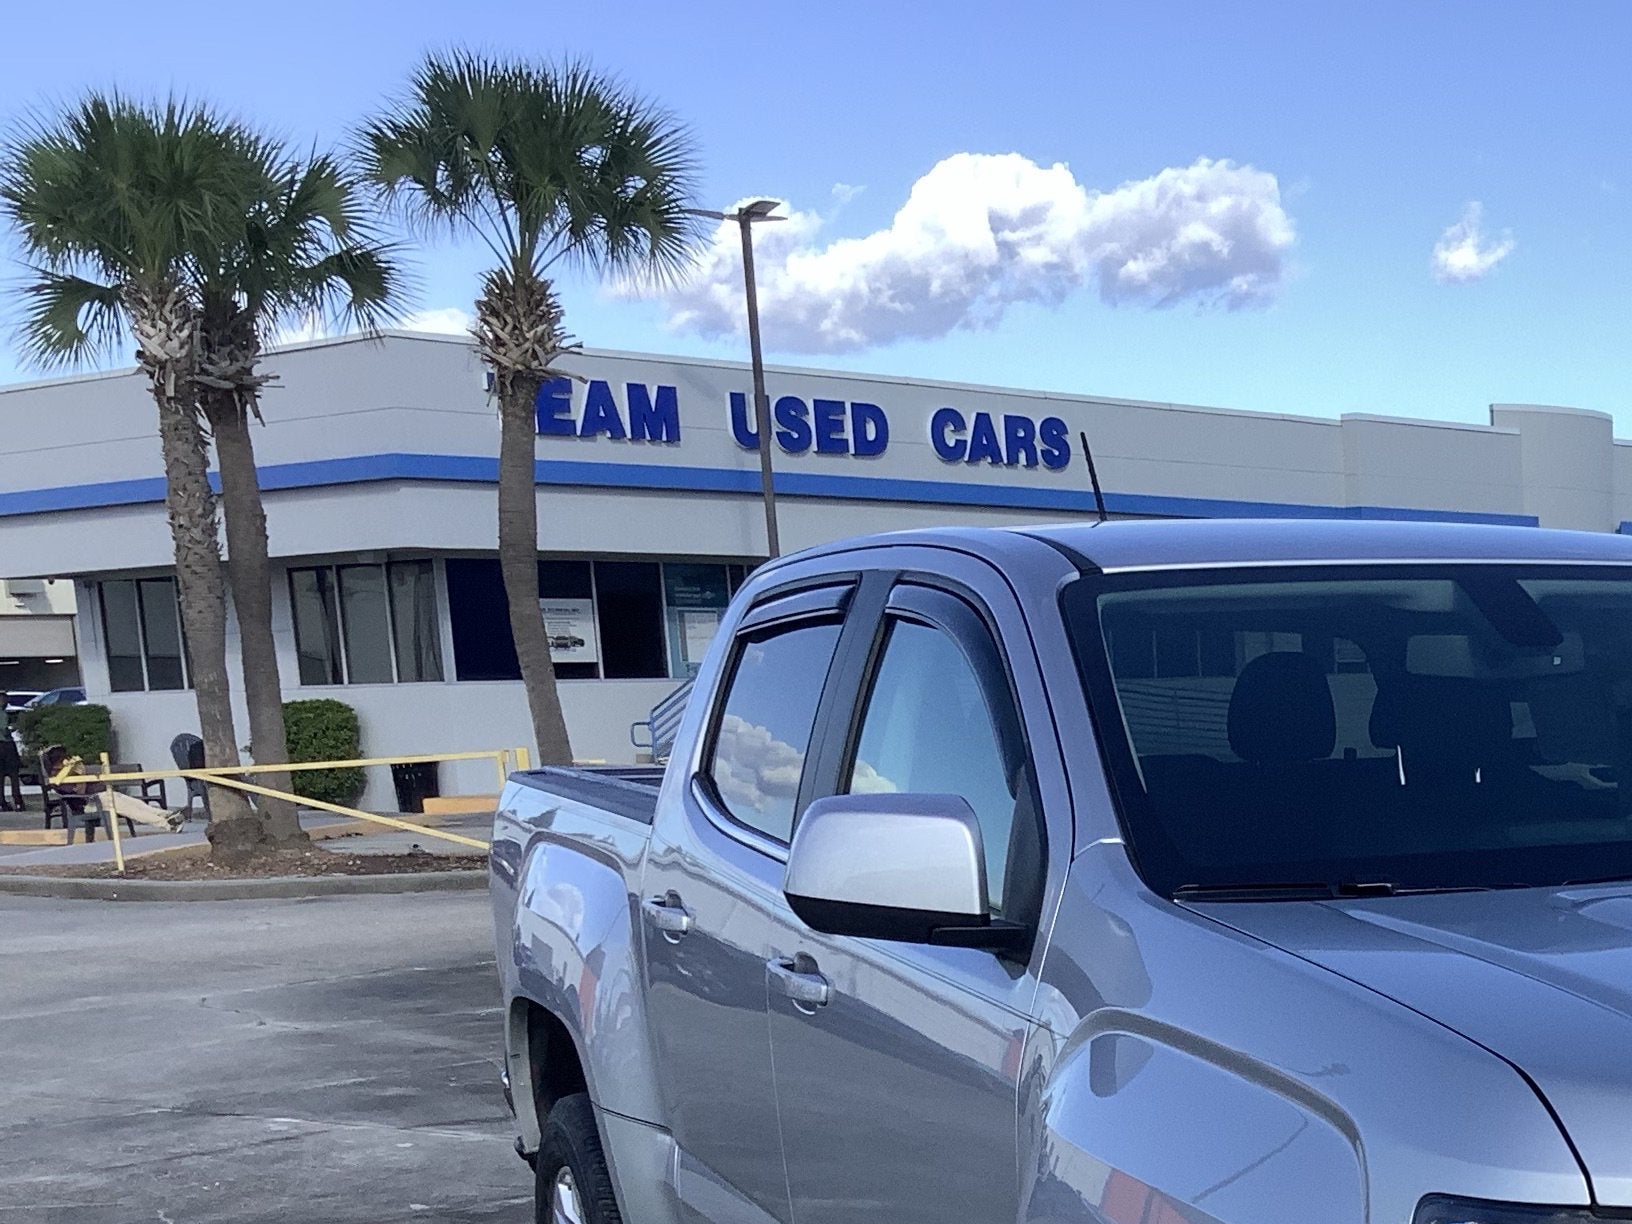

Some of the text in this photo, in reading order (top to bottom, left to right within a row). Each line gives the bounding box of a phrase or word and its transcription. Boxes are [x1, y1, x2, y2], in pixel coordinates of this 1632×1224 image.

[483, 373, 1071, 471] EAM USED CARS
